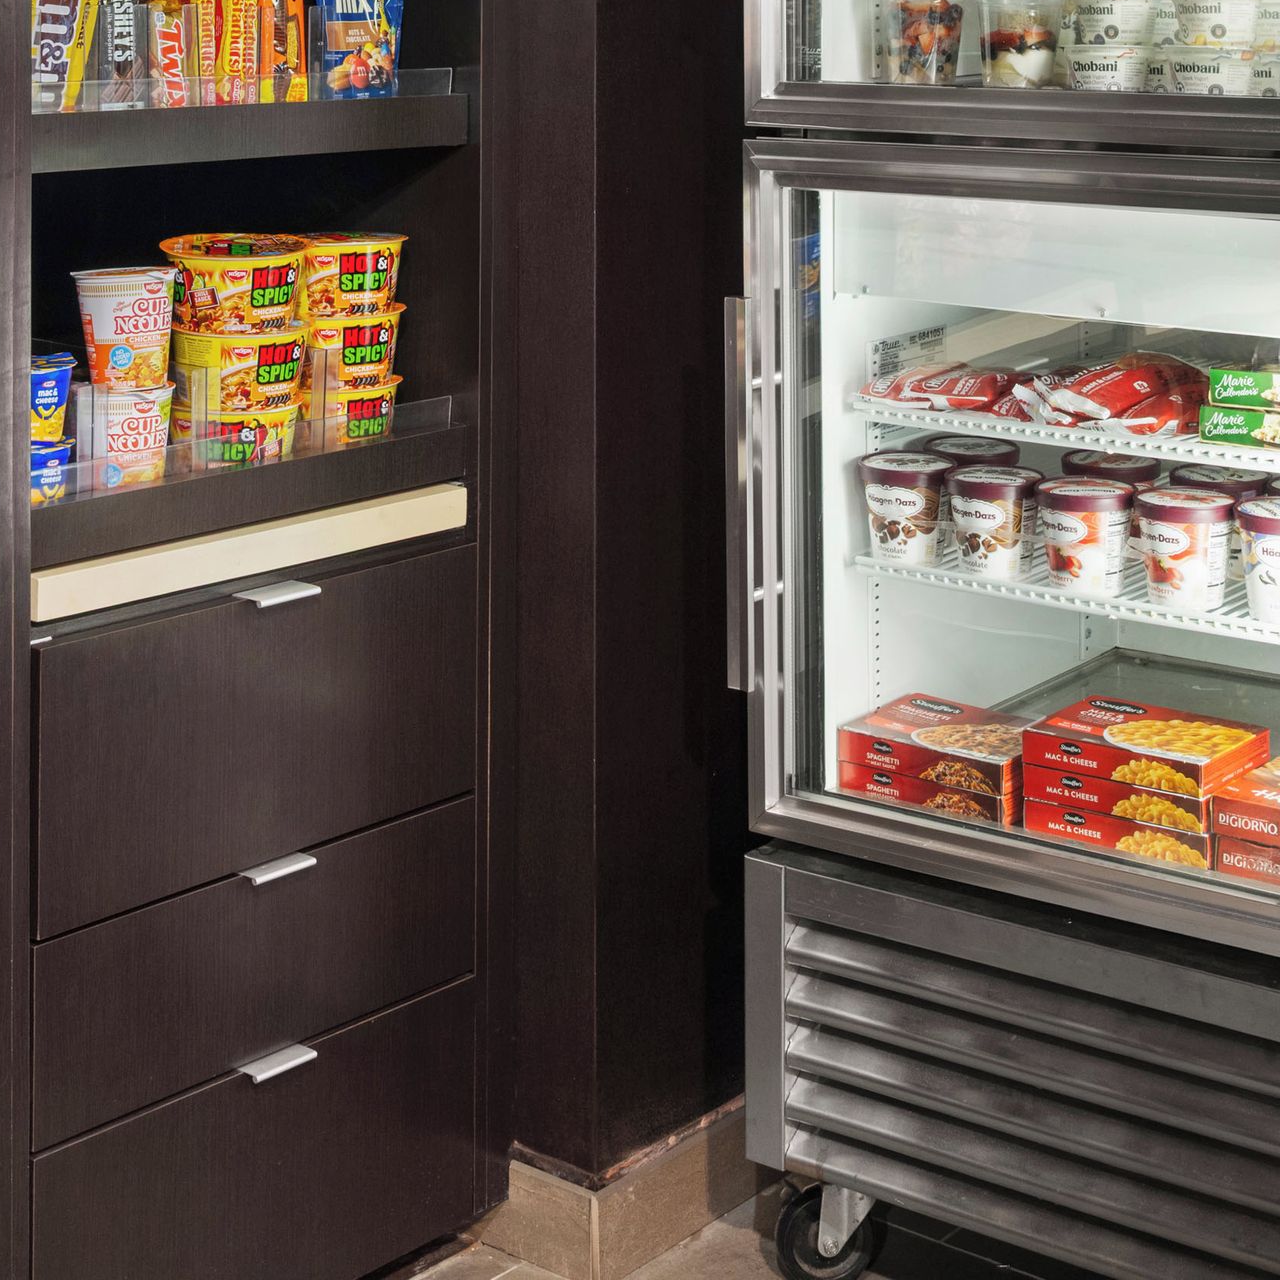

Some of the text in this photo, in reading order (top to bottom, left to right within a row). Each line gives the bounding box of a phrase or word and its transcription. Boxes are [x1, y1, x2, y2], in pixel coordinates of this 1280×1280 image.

[1178, 3, 1221, 15] Chobani
[1073, 61, 1118, 74] Chobani
[1174, 62, 1220, 74] Chobani
[340, 252, 379, 273] HOT
[253, 267, 288, 289] HOT
[340, 271, 386, 292] SPICY
[252, 284, 293, 307] SPICY
[132, 298, 169, 316] CUP
[344, 325, 380, 346] HOT
[344, 344, 387, 365] SPICY
[1220, 374, 1254, 388] Marie
[1215, 387, 1258, 399] Callender's
[122, 416, 161, 435] CUP
[1211, 413, 1245, 426] Marie
[1205, 424, 1248, 437] Callender's
[108, 429, 167, 452] NOODLES
[867, 752, 899, 765] SPAGHETTI
[1045, 752, 1097, 768] MAC CHEESE
[867, 784, 899, 796] SPAGHETTI
[1048, 822, 1101, 839] MAC CHEESE
[1218, 812, 1278, 835] DIGIORNO
